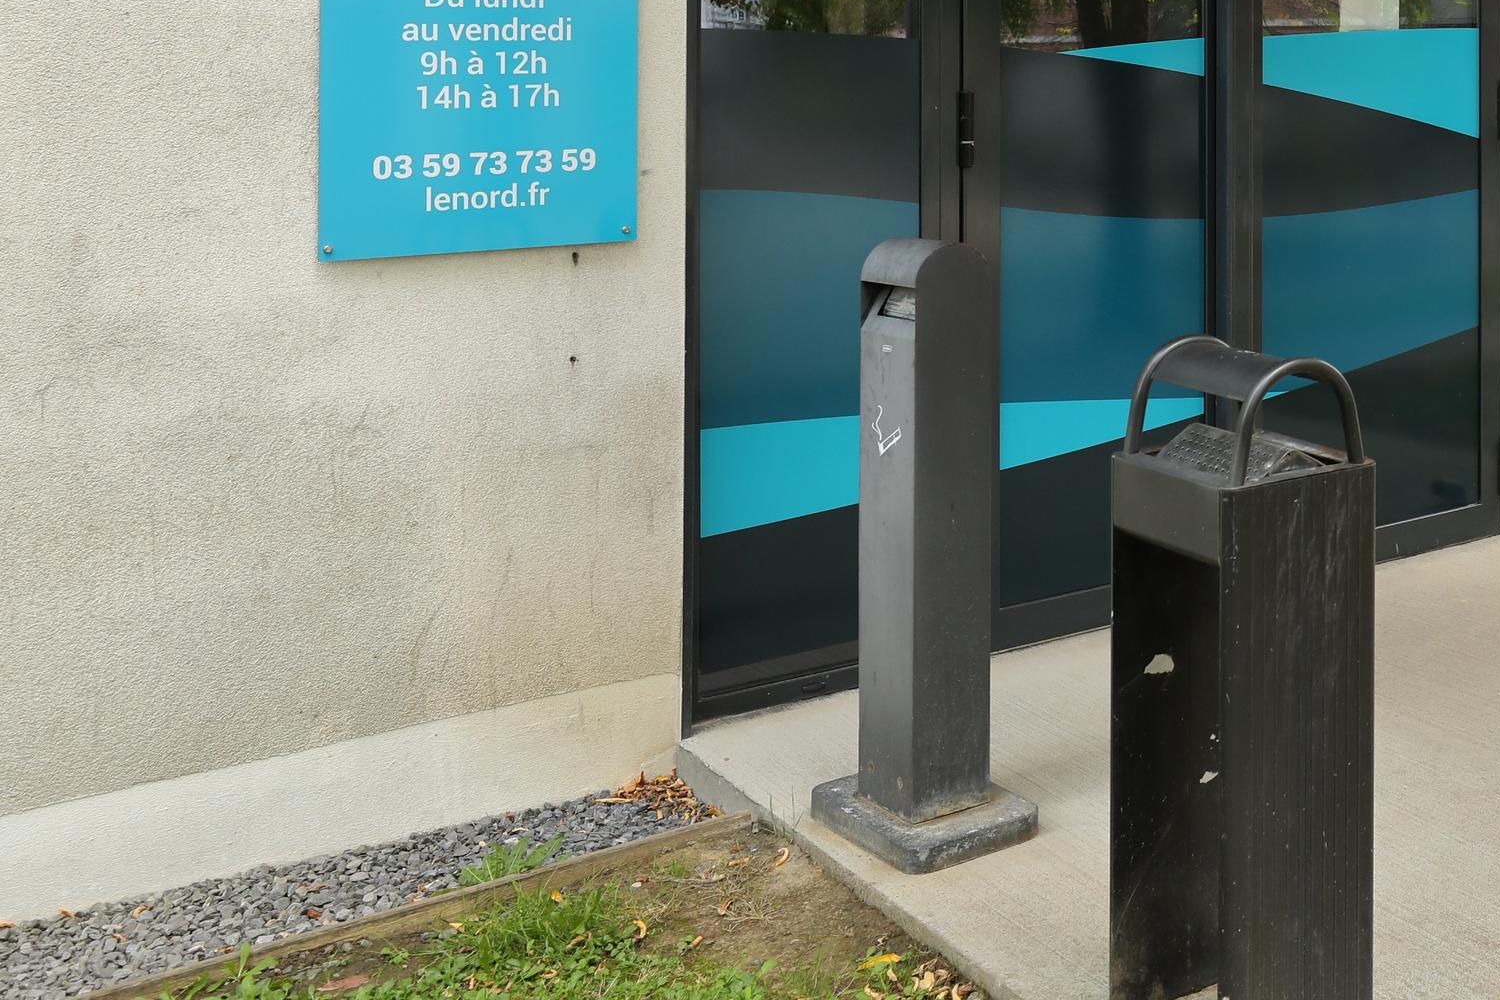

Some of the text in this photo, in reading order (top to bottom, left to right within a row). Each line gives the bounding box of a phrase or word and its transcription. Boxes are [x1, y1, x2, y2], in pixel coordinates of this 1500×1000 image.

[402, 17, 573, 42] au vendredi
[420, 50, 547, 76] 9h à 12h
[416, 83, 561, 110] 14h à 17h
[372, 148, 596, 180] 03 59 73 73 59
[425, 181, 550, 212] lenord.fr
